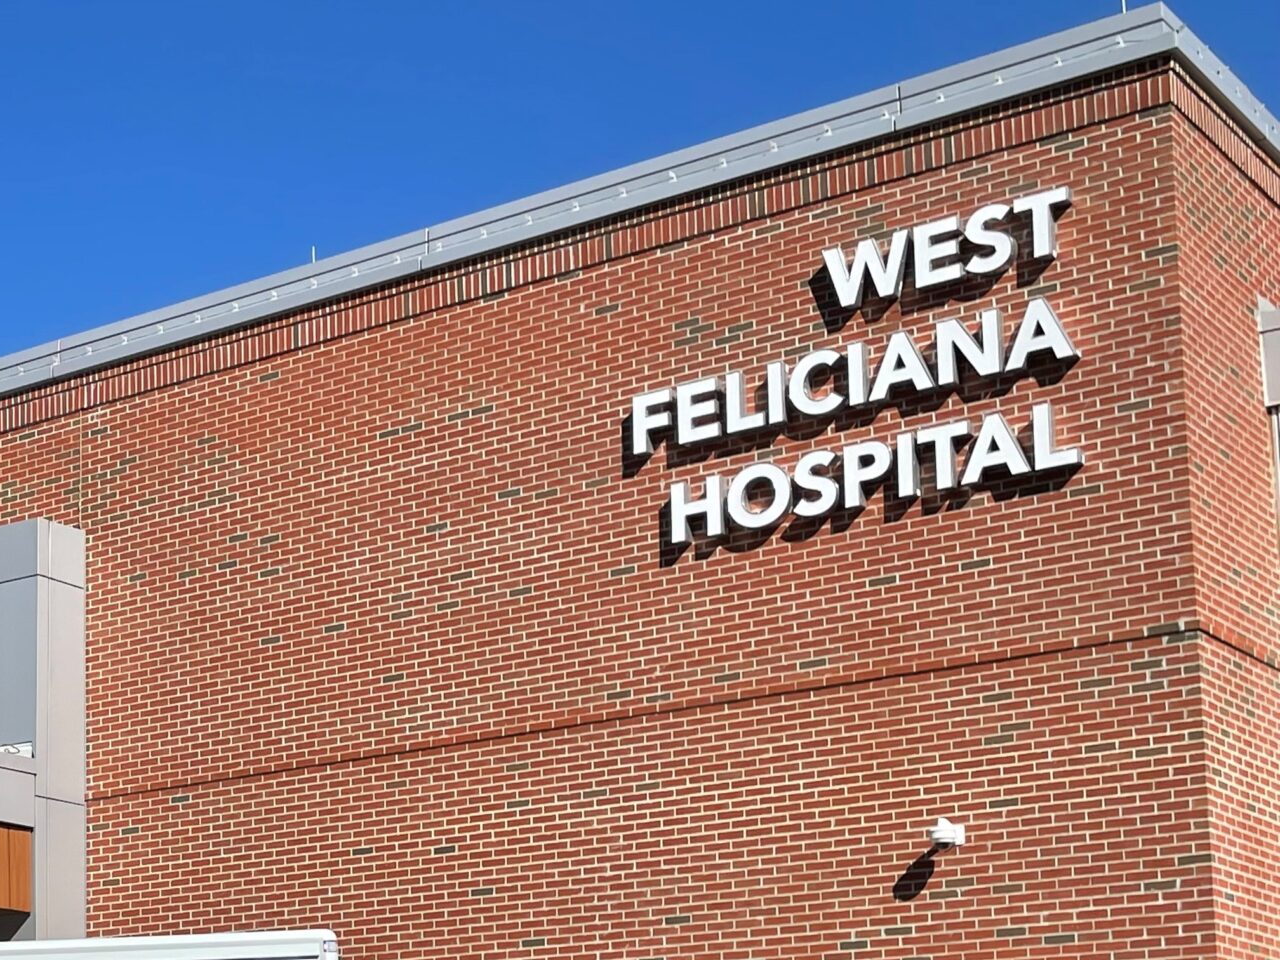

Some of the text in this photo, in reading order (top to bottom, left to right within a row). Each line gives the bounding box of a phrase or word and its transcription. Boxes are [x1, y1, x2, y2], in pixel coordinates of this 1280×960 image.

[821, 186, 1072, 309] WEST
[631, 296, 1082, 455] FELICIANA
[670, 402, 1084, 544] HOSPITAL
